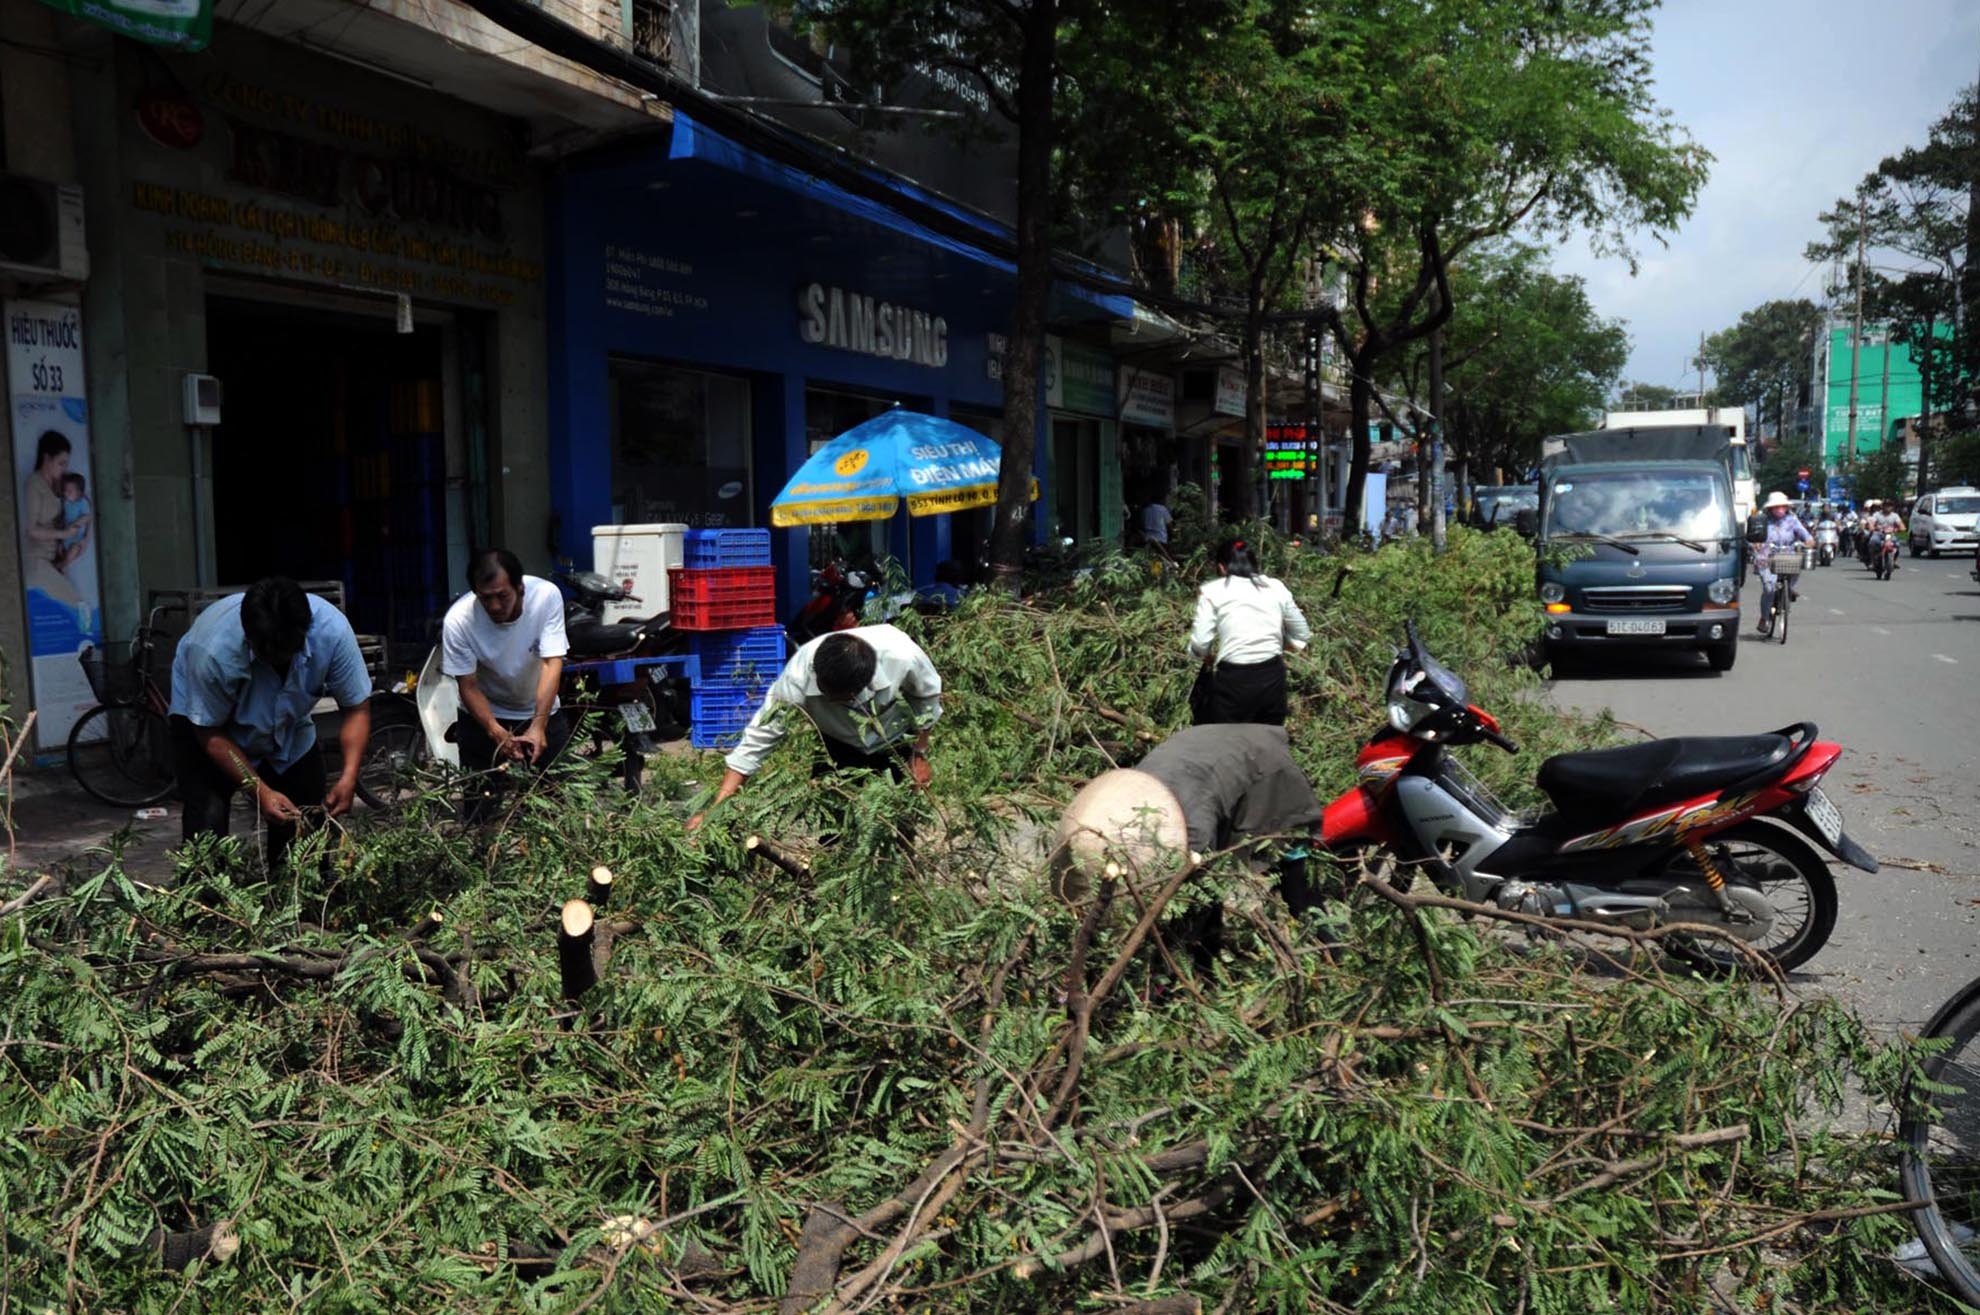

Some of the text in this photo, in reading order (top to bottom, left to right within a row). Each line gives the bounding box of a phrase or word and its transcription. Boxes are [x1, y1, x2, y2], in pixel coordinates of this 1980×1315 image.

[11, 310, 78, 353] HIỆU THUỐC
[799, 281, 950, 368] SAMSUNG
[32, 355, 64, 392] SỐ 33
[911, 441, 949, 461] SIÊU
[910, 464, 961, 486] ĐIỆN
